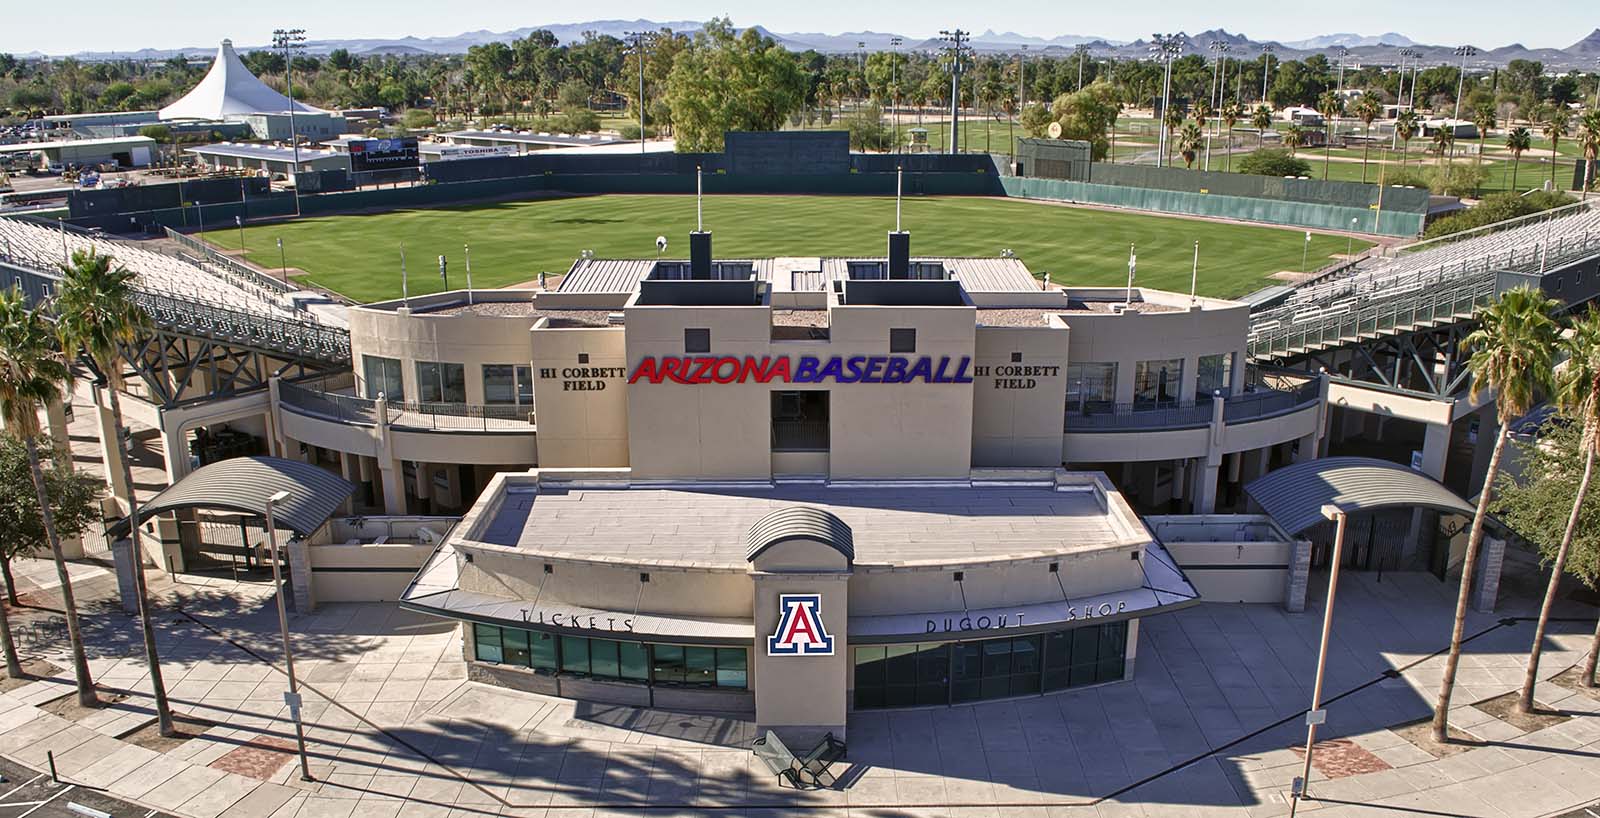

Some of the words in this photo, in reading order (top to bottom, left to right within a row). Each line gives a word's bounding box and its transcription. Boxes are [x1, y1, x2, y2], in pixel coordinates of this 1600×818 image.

[540, 367, 557, 378] HI
[562, 367, 626, 379] CORBETT
[627, 355, 791, 384] ARIZONA
[791, 355, 974, 384] BASEBALL
[974, 366, 990, 377] HI
[995, 365, 1060, 377] CORBETT
[563, 380, 606, 391] FIELD
[994, 379, 1036, 389] FIELD
[520, 609, 633, 632] TICKETS
[768, 594, 834, 656] A
[926, 612, 1025, 633] DUGOUT
[1067, 600, 1126, 621] SHOP
